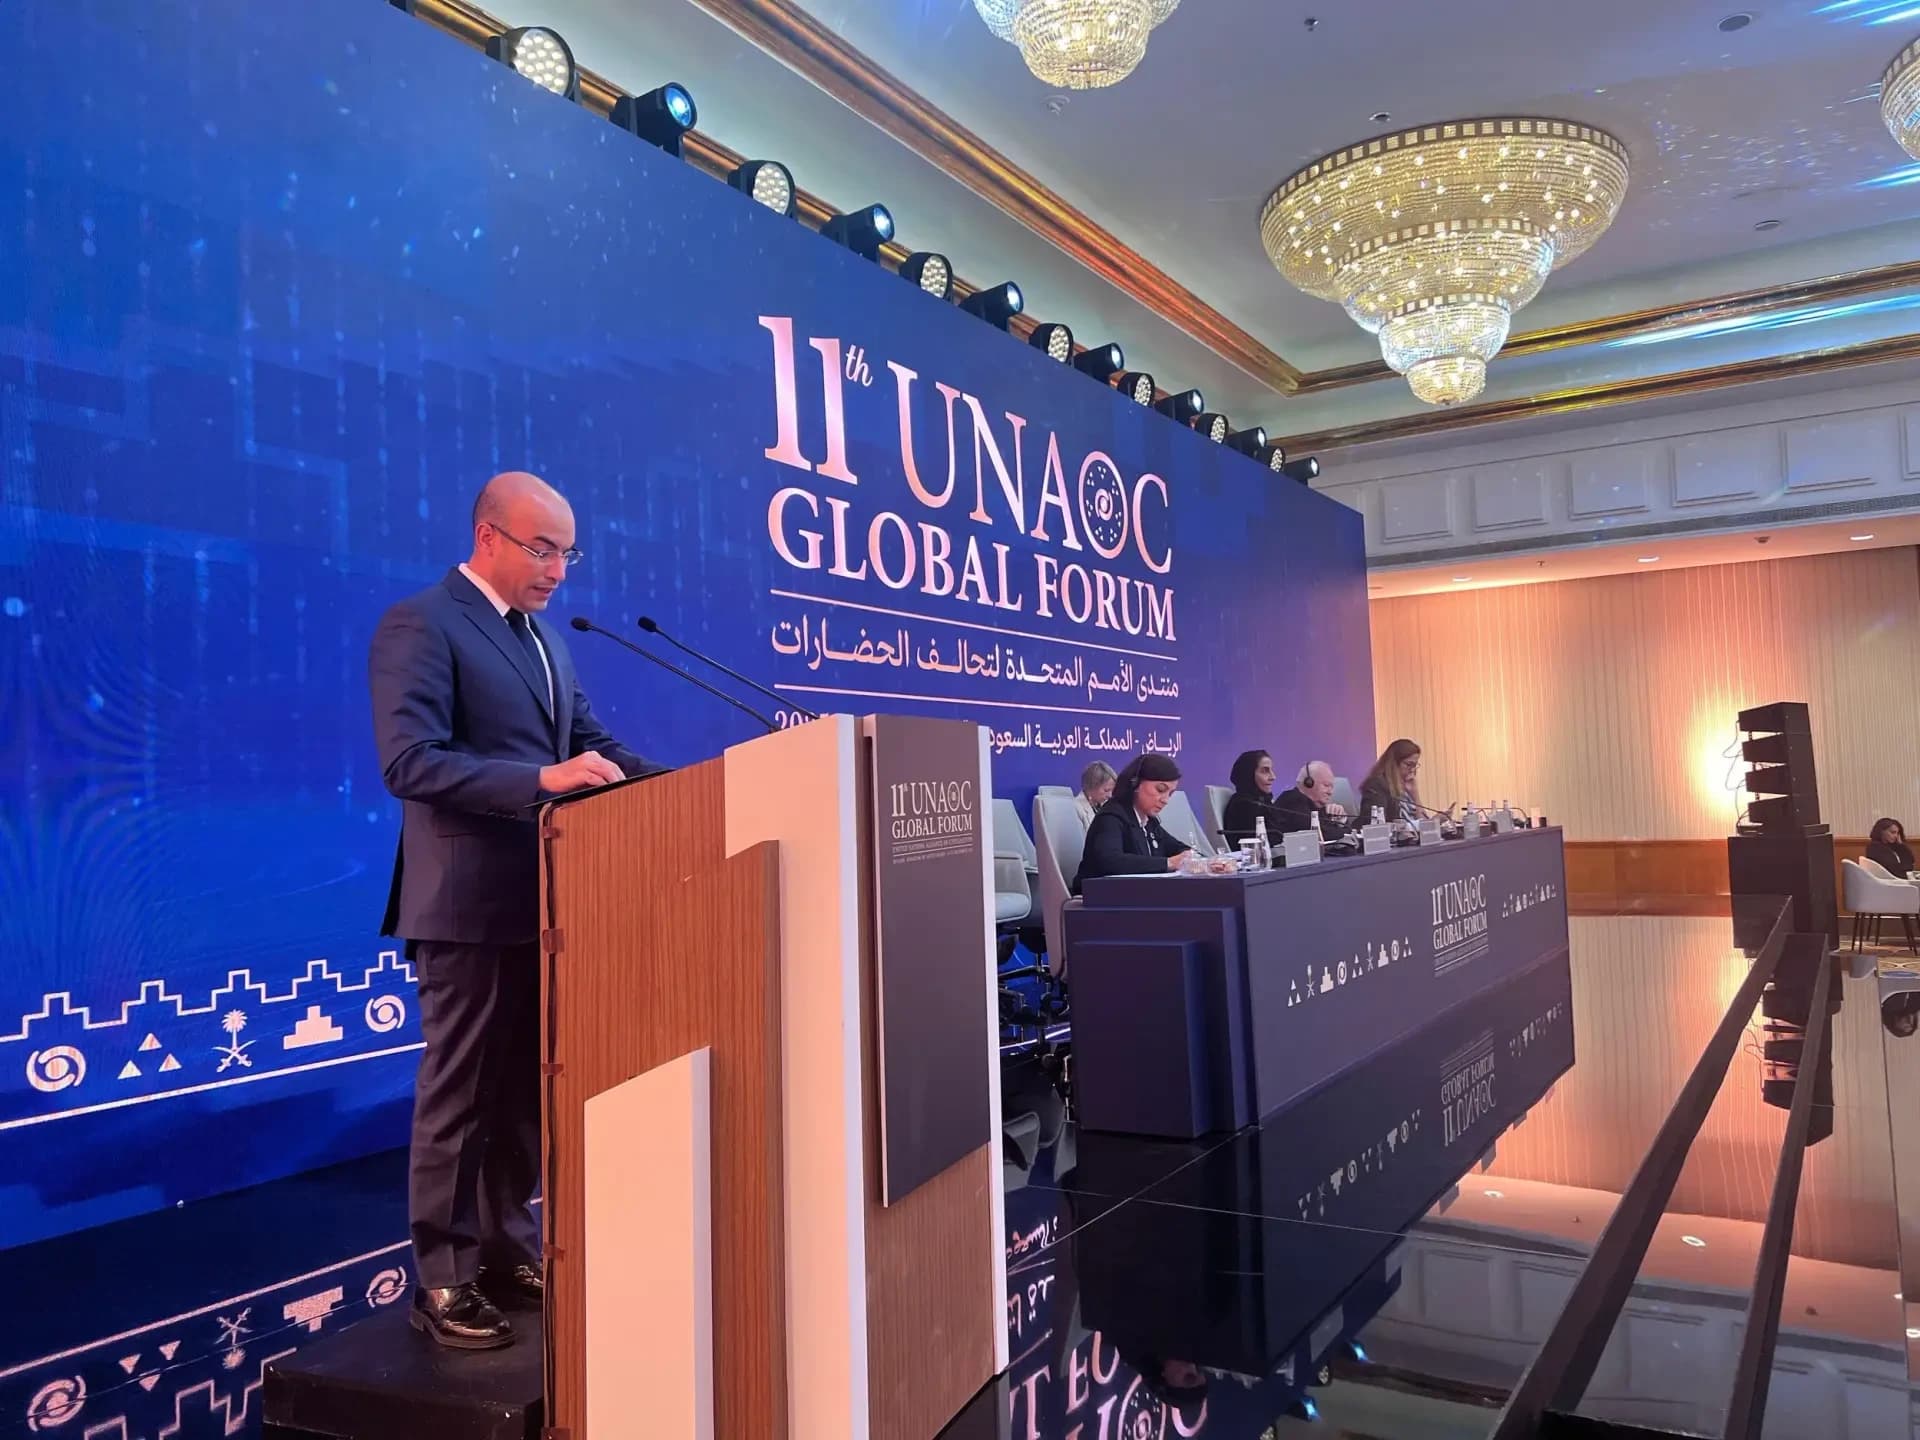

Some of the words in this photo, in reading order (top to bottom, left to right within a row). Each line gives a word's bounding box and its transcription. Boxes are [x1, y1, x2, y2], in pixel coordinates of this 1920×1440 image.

[758, 315, 873, 485] 11th
[887, 360, 1172, 574] UNAOC
[767, 487, 1022, 612] GLOBAL
[1034, 553, 1177, 642] FORUM
[771, 614, 910, 671] الحضارات
[916, 637, 1000, 678] لتحالف
[1006, 648, 1083, 688] المتحدة
[1088, 659, 1133, 702] الأمم
[1137, 675, 1179, 702] منتدى
[774, 710, 830, 729] 20
[1035, 723, 1081, 756] العربية
[1084, 727, 1133, 751] المملكة
[1141, 731, 1182, 758] الرياض
[910, 780, 972, 815] UNAOC
[891, 817, 936, 839] GLOBAL
[937, 813, 973, 834] FORUM
[1444, 873, 1487, 920] UNAOC
[1433, 920, 1463, 950] GLOBAL
[1463, 910, 1488, 938] FORUM
